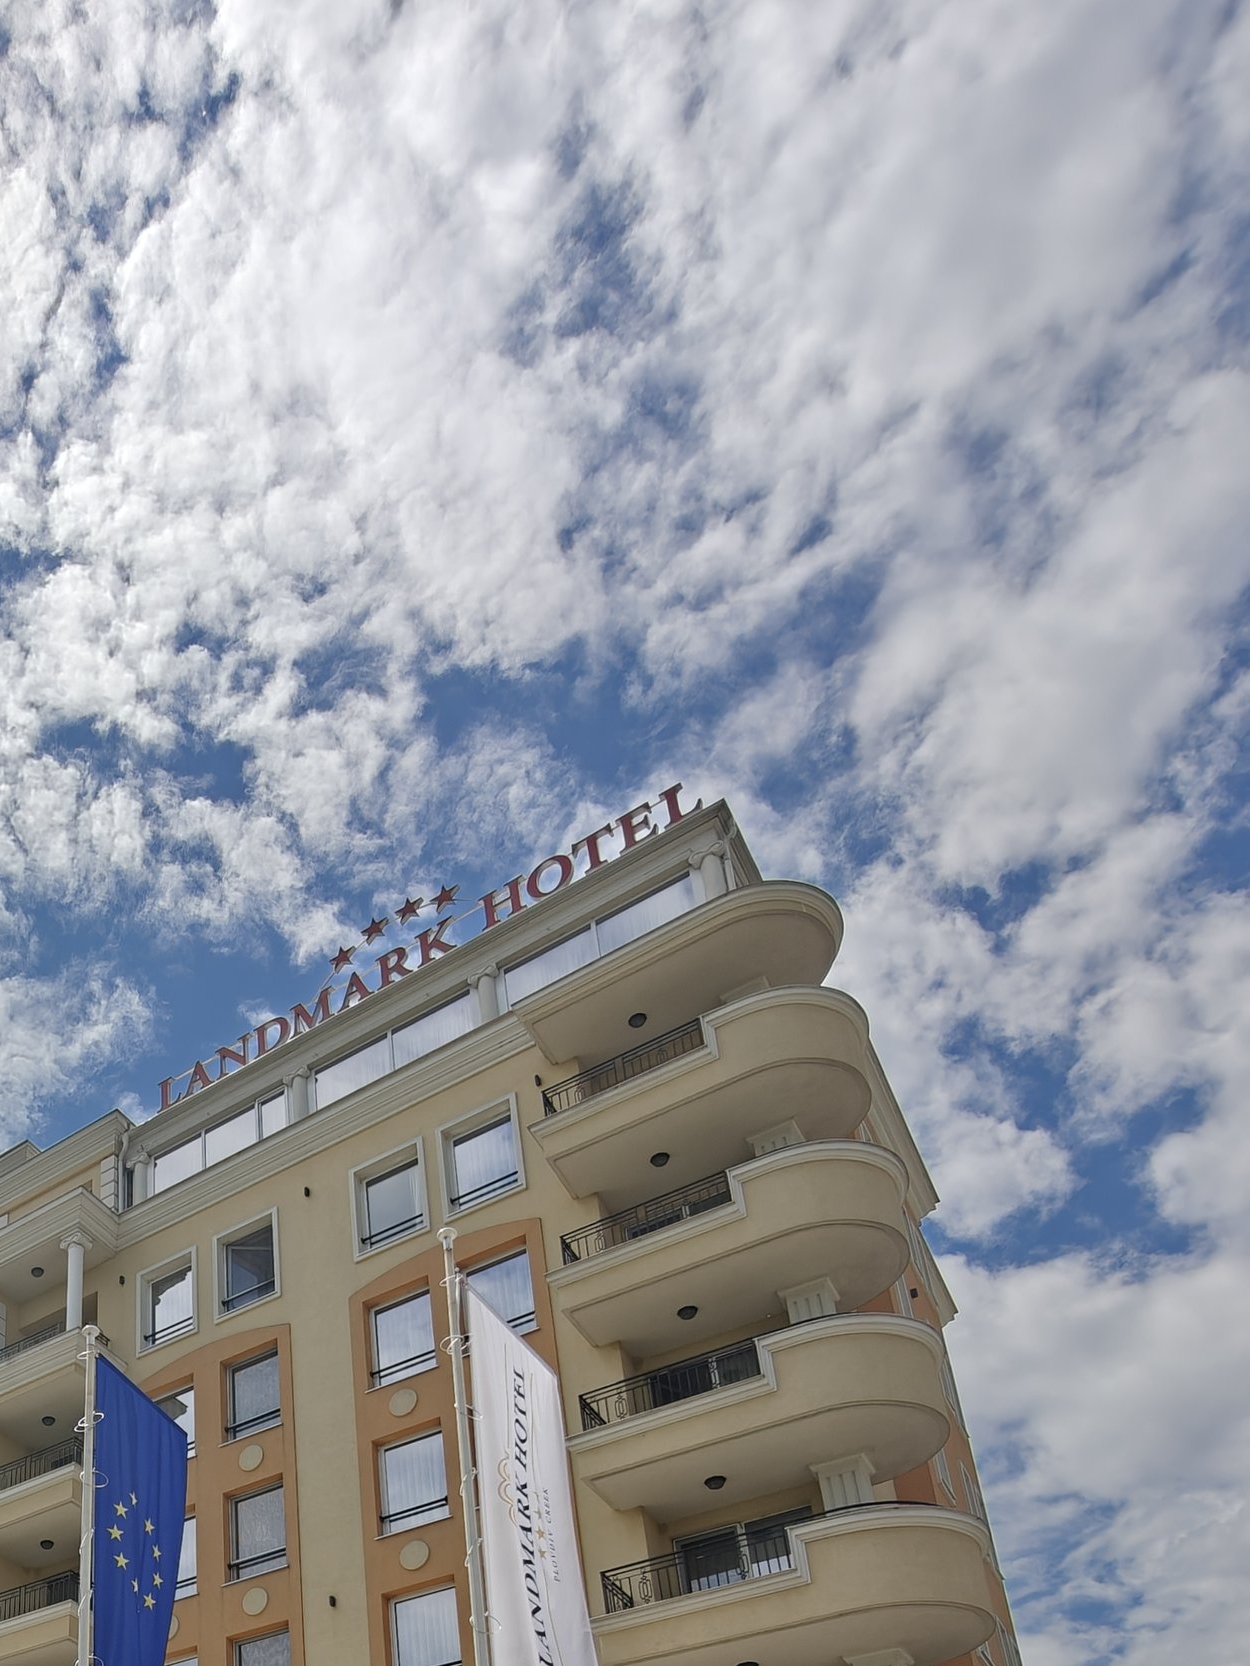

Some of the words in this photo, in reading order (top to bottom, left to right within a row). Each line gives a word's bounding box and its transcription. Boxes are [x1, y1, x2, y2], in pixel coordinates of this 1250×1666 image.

[157, 915, 458, 1113] LANDMARK
[478, 781, 703, 931] HOTEL
[513, 1363, 528, 1472] HOTEL
